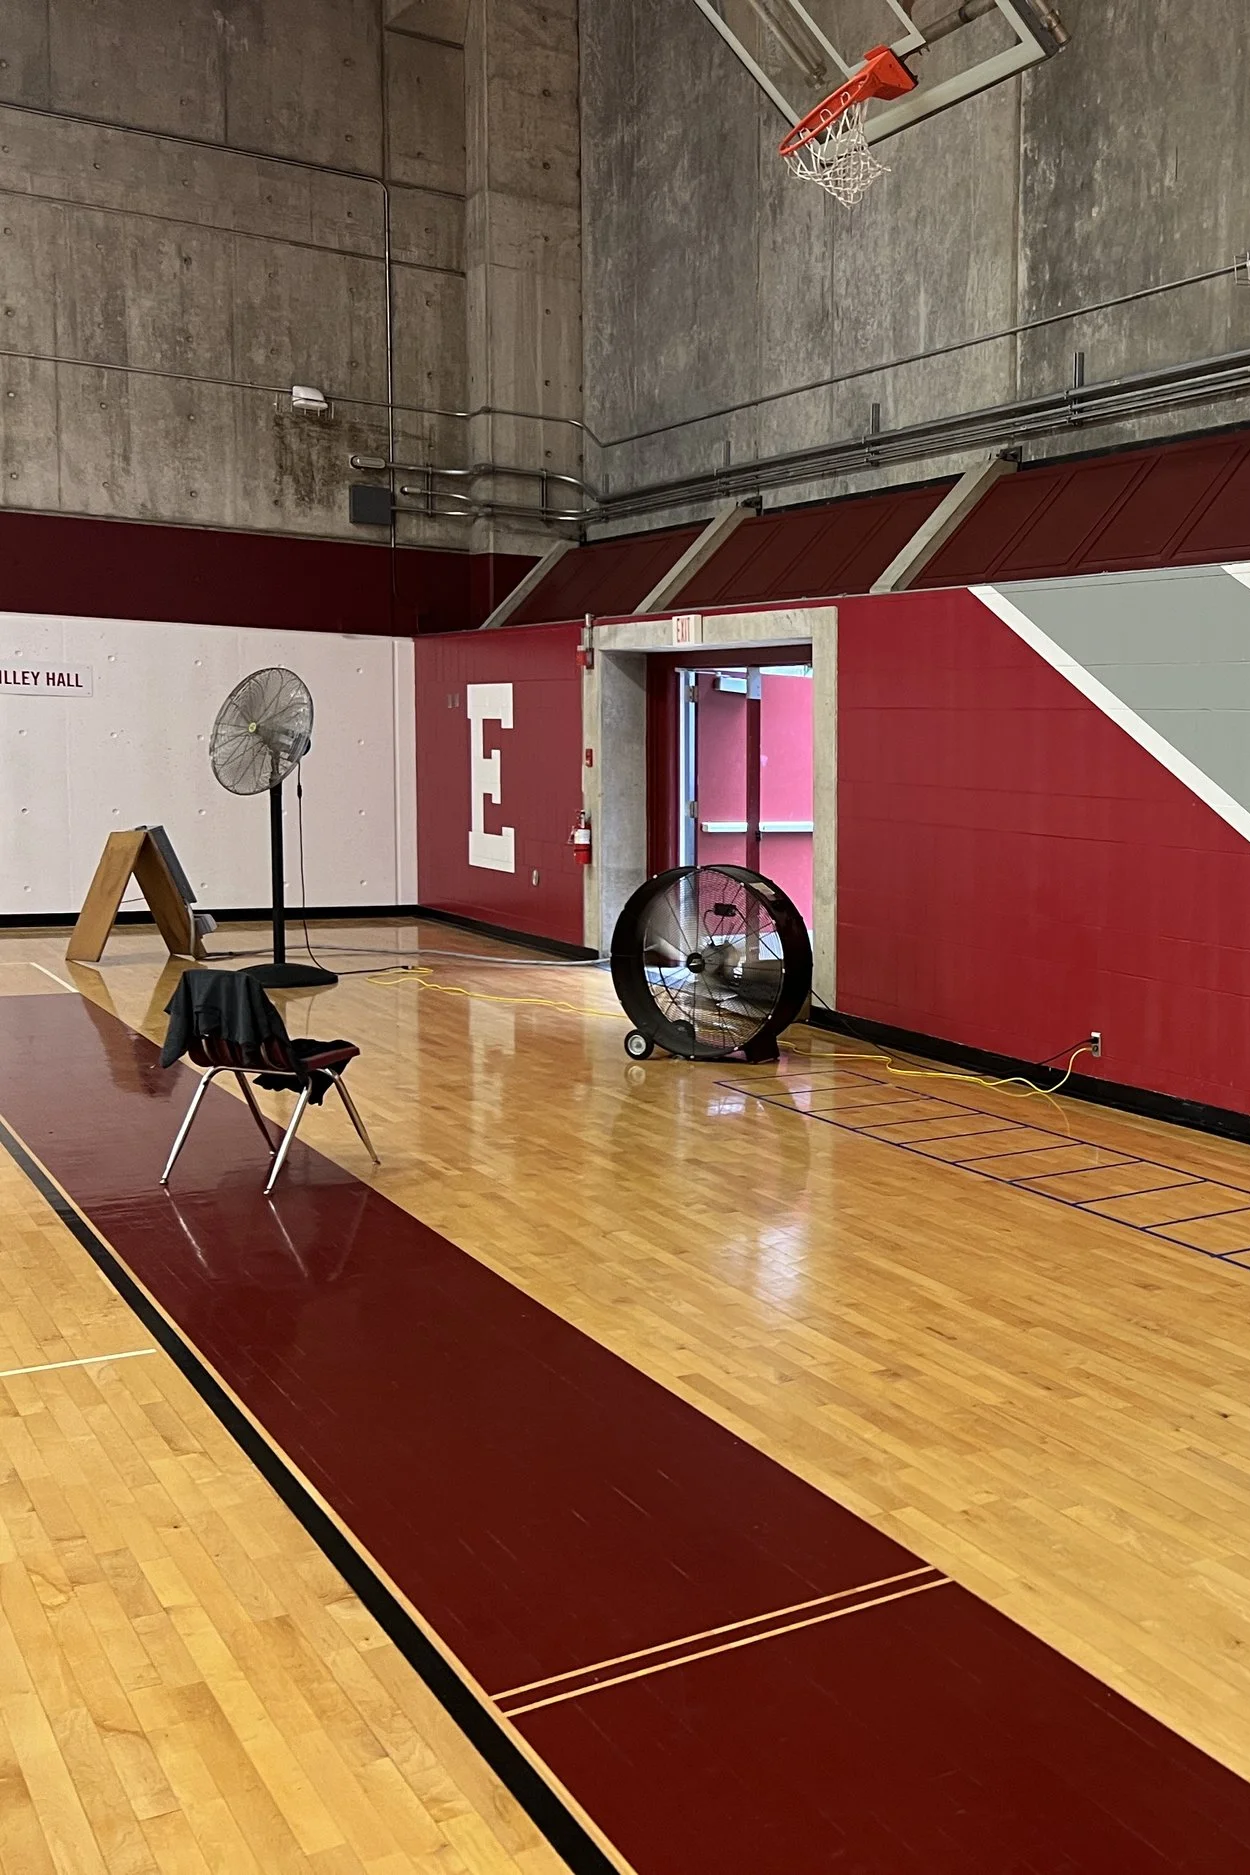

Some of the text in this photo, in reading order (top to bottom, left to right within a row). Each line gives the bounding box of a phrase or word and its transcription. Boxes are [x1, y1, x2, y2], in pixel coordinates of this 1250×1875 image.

[676, 616, 691, 642] EXIT
[46, 671, 83, 688] HALL
[467, 682, 515, 874] E
